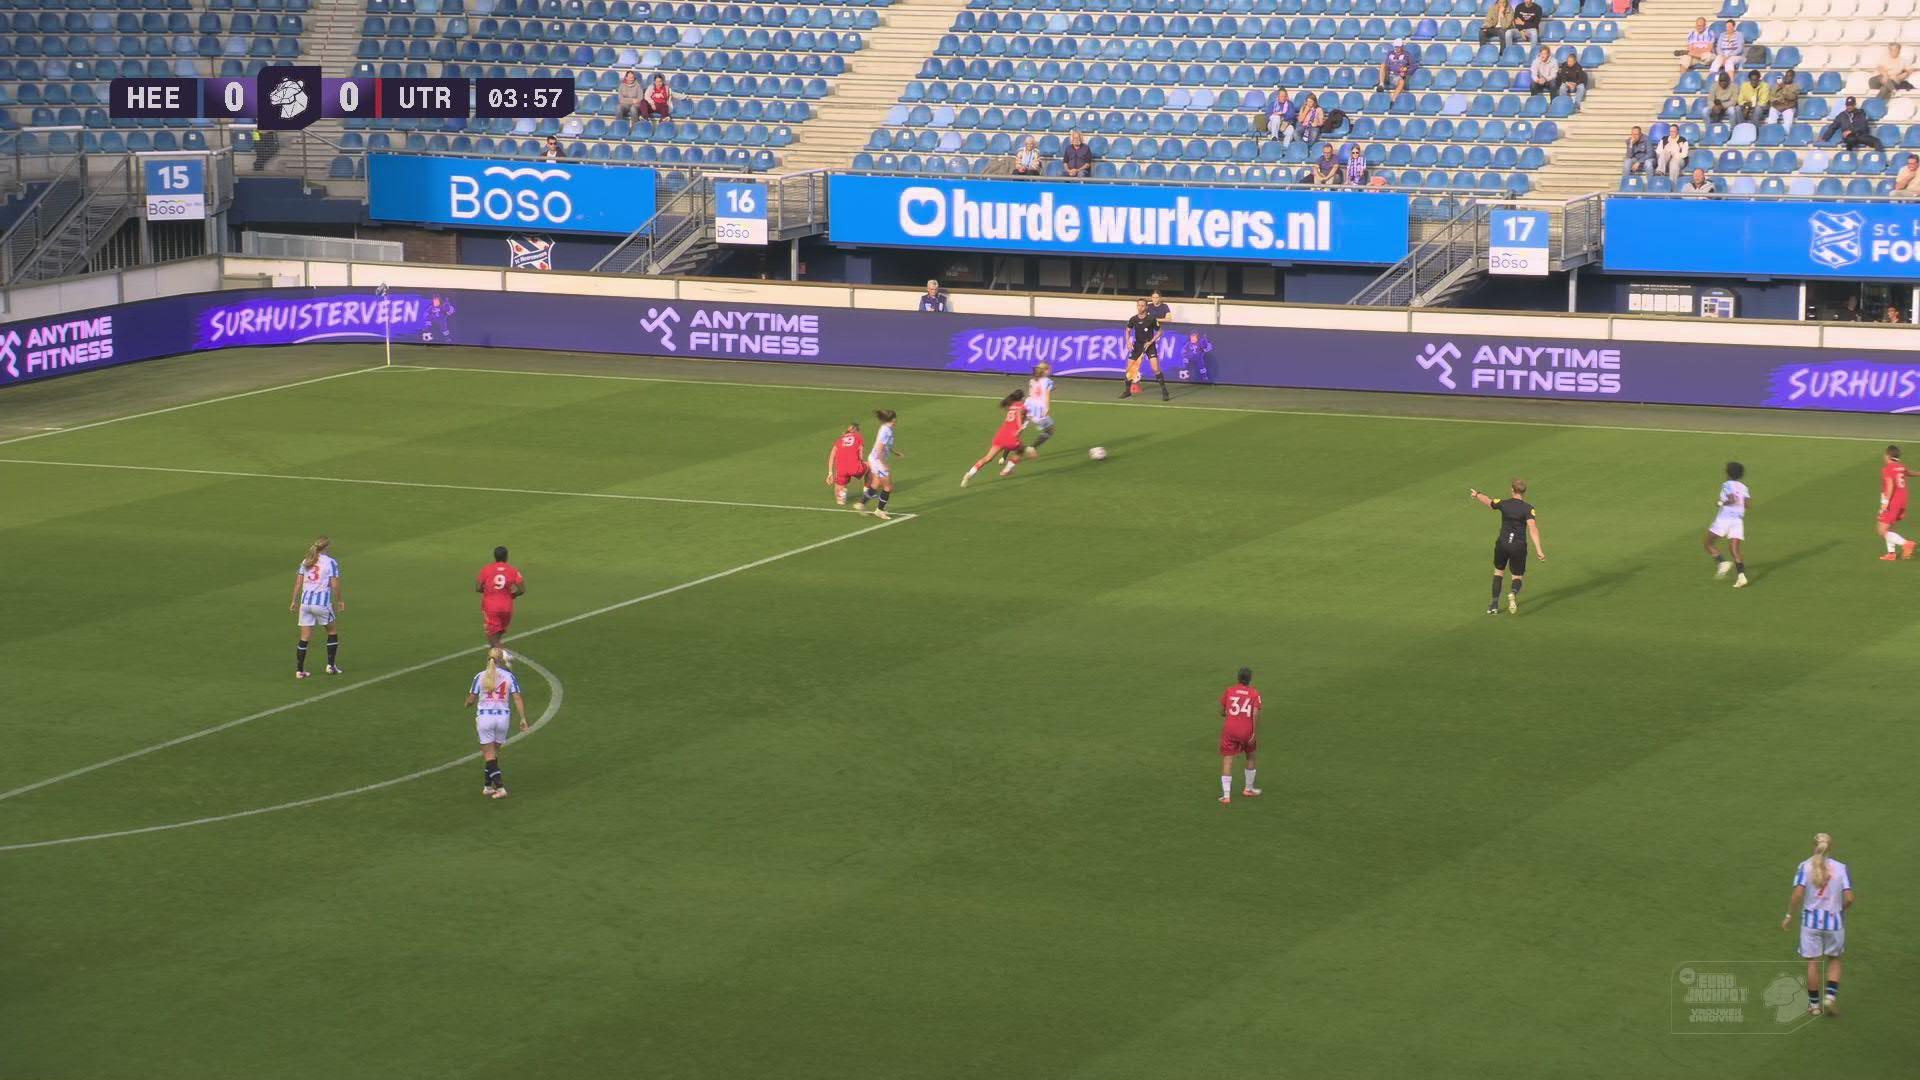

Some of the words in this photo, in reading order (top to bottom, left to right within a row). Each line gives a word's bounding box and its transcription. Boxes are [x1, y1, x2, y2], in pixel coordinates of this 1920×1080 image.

[158, 165, 190, 190] 15
[727, 189, 756, 214] 16
[952, 188, 1081, 243] hurde
[1089, 194, 1332, 252] wurkers.nl
[1503, 216, 1537, 242] 17
[25, 316, 113, 350] ANYTIME
[210, 299, 420, 342] SURHUISTERVEEN
[689, 309, 820, 335] ANYTIME
[27, 337, 114, 373] FITNESS
[689, 331, 820, 357] FITNESS
[967, 333, 1176, 364] SURHUISTERVN
[1472, 345, 1621, 370] ANYTIME
[1472, 367, 1621, 394] FITNESS
[1788, 367, 1920, 400] SURHUIS
[308, 565, 321, 582] 3
[494, 574, 506, 590] 9
[1228, 696, 1252, 718] 34
